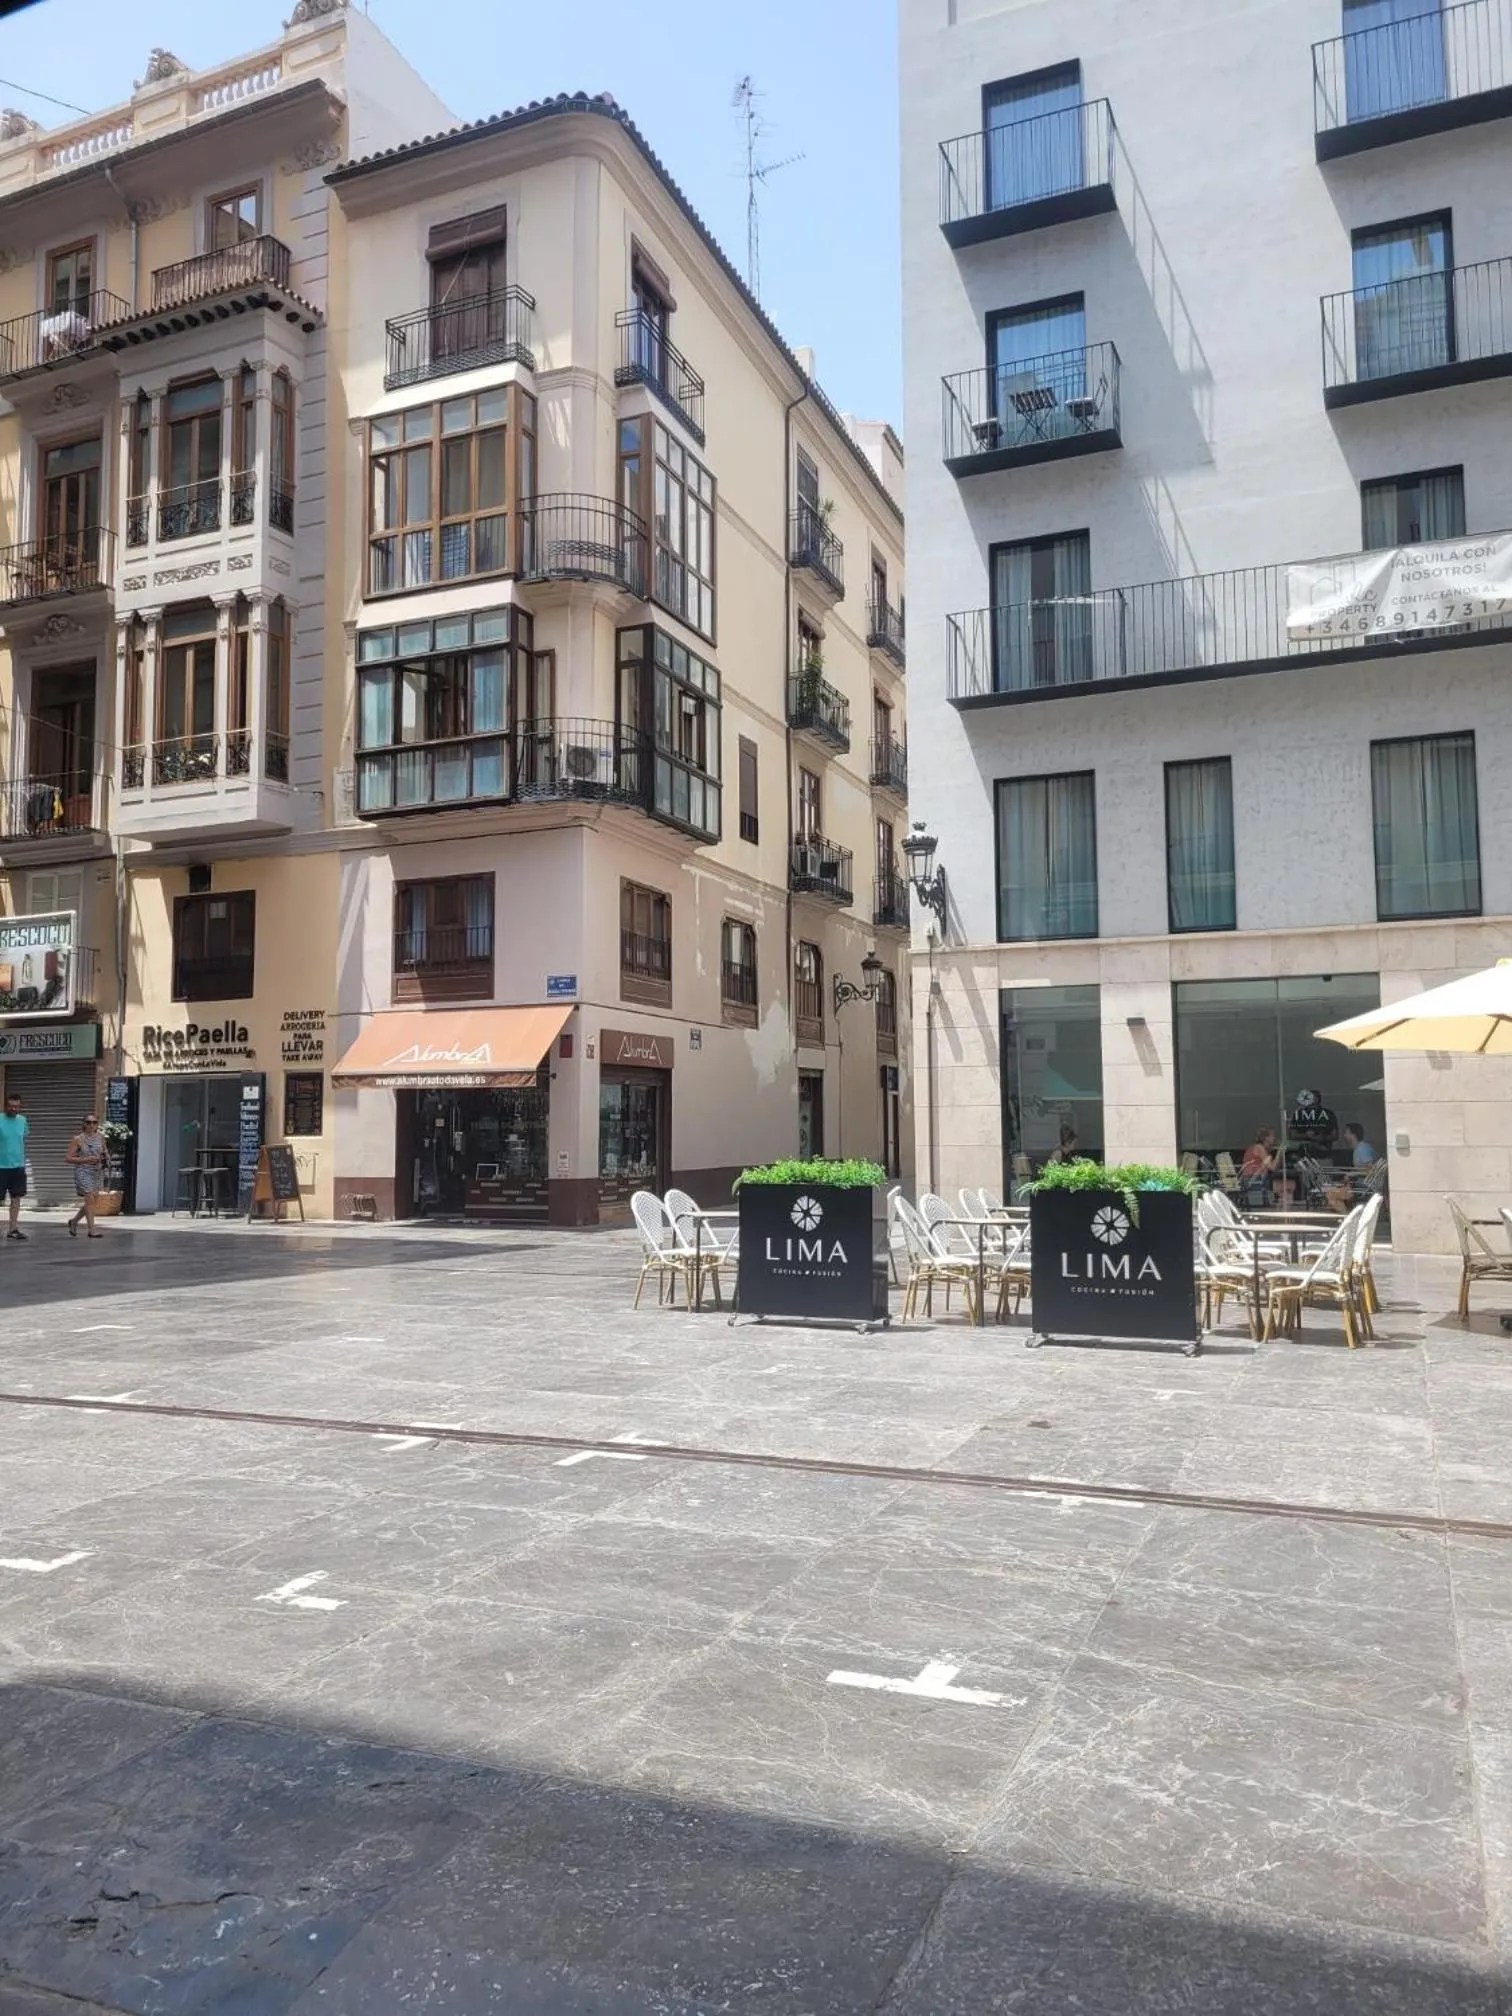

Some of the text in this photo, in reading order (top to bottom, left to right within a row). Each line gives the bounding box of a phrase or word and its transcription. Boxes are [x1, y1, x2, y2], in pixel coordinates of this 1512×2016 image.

[1463, 546, 1496, 559] CON
[283, 1010, 325, 1021] DELIVERY
[143, 1020, 248, 1046] RicePaella
[281, 1040, 324, 1052] LLEVAR
[282, 1053, 323, 1062] TAKE AWAY
[766, 1237, 848, 1263] LIMA
[1061, 1252, 1162, 1281] LIMA
